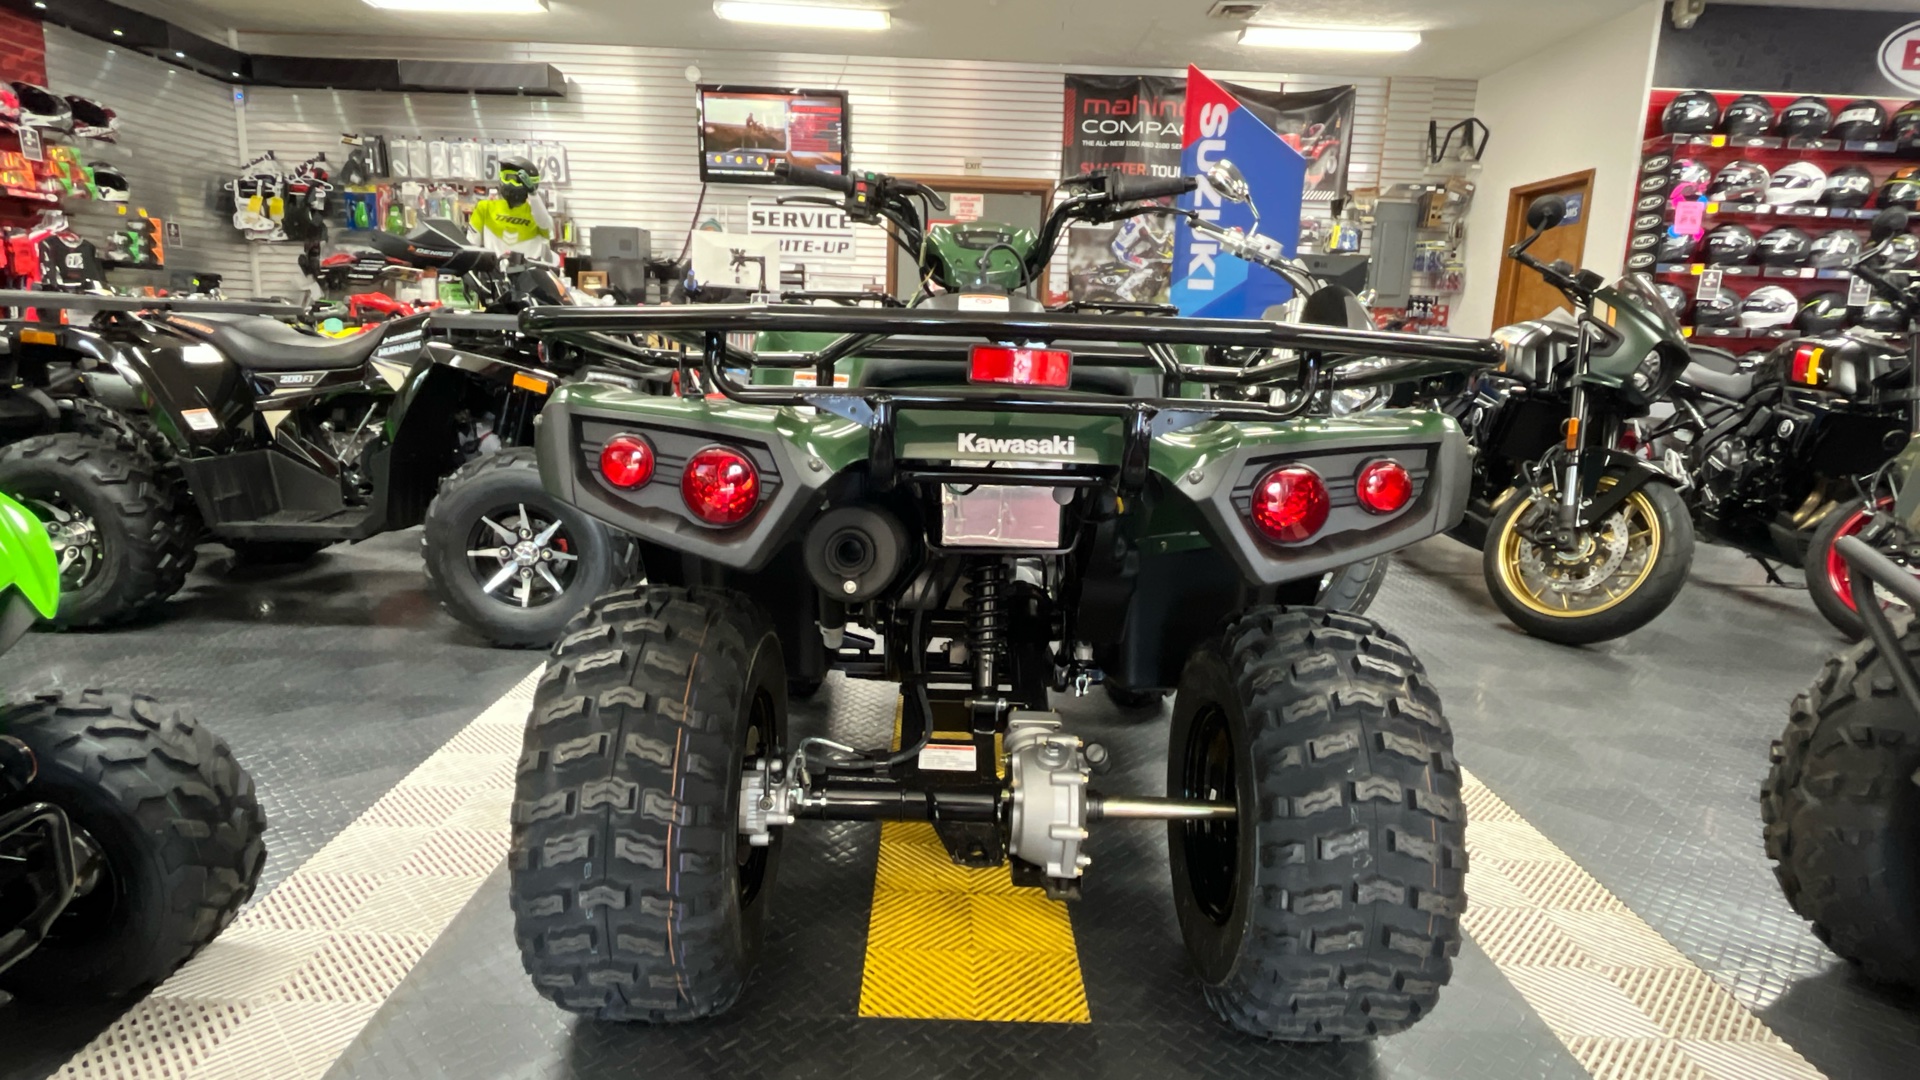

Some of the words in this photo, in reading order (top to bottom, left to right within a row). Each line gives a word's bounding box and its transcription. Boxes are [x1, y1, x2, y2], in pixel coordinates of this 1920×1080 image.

[1082, 139, 1094, 147] THE
[485, 154, 496, 180] 5
[548, 156, 561, 181] 9
[1187, 102, 1229, 291] SUZUKI
[495, 214, 531, 226] THOR
[752, 211, 851, 229] SERVICE
[958, 432, 1075, 455] Kawasaki
